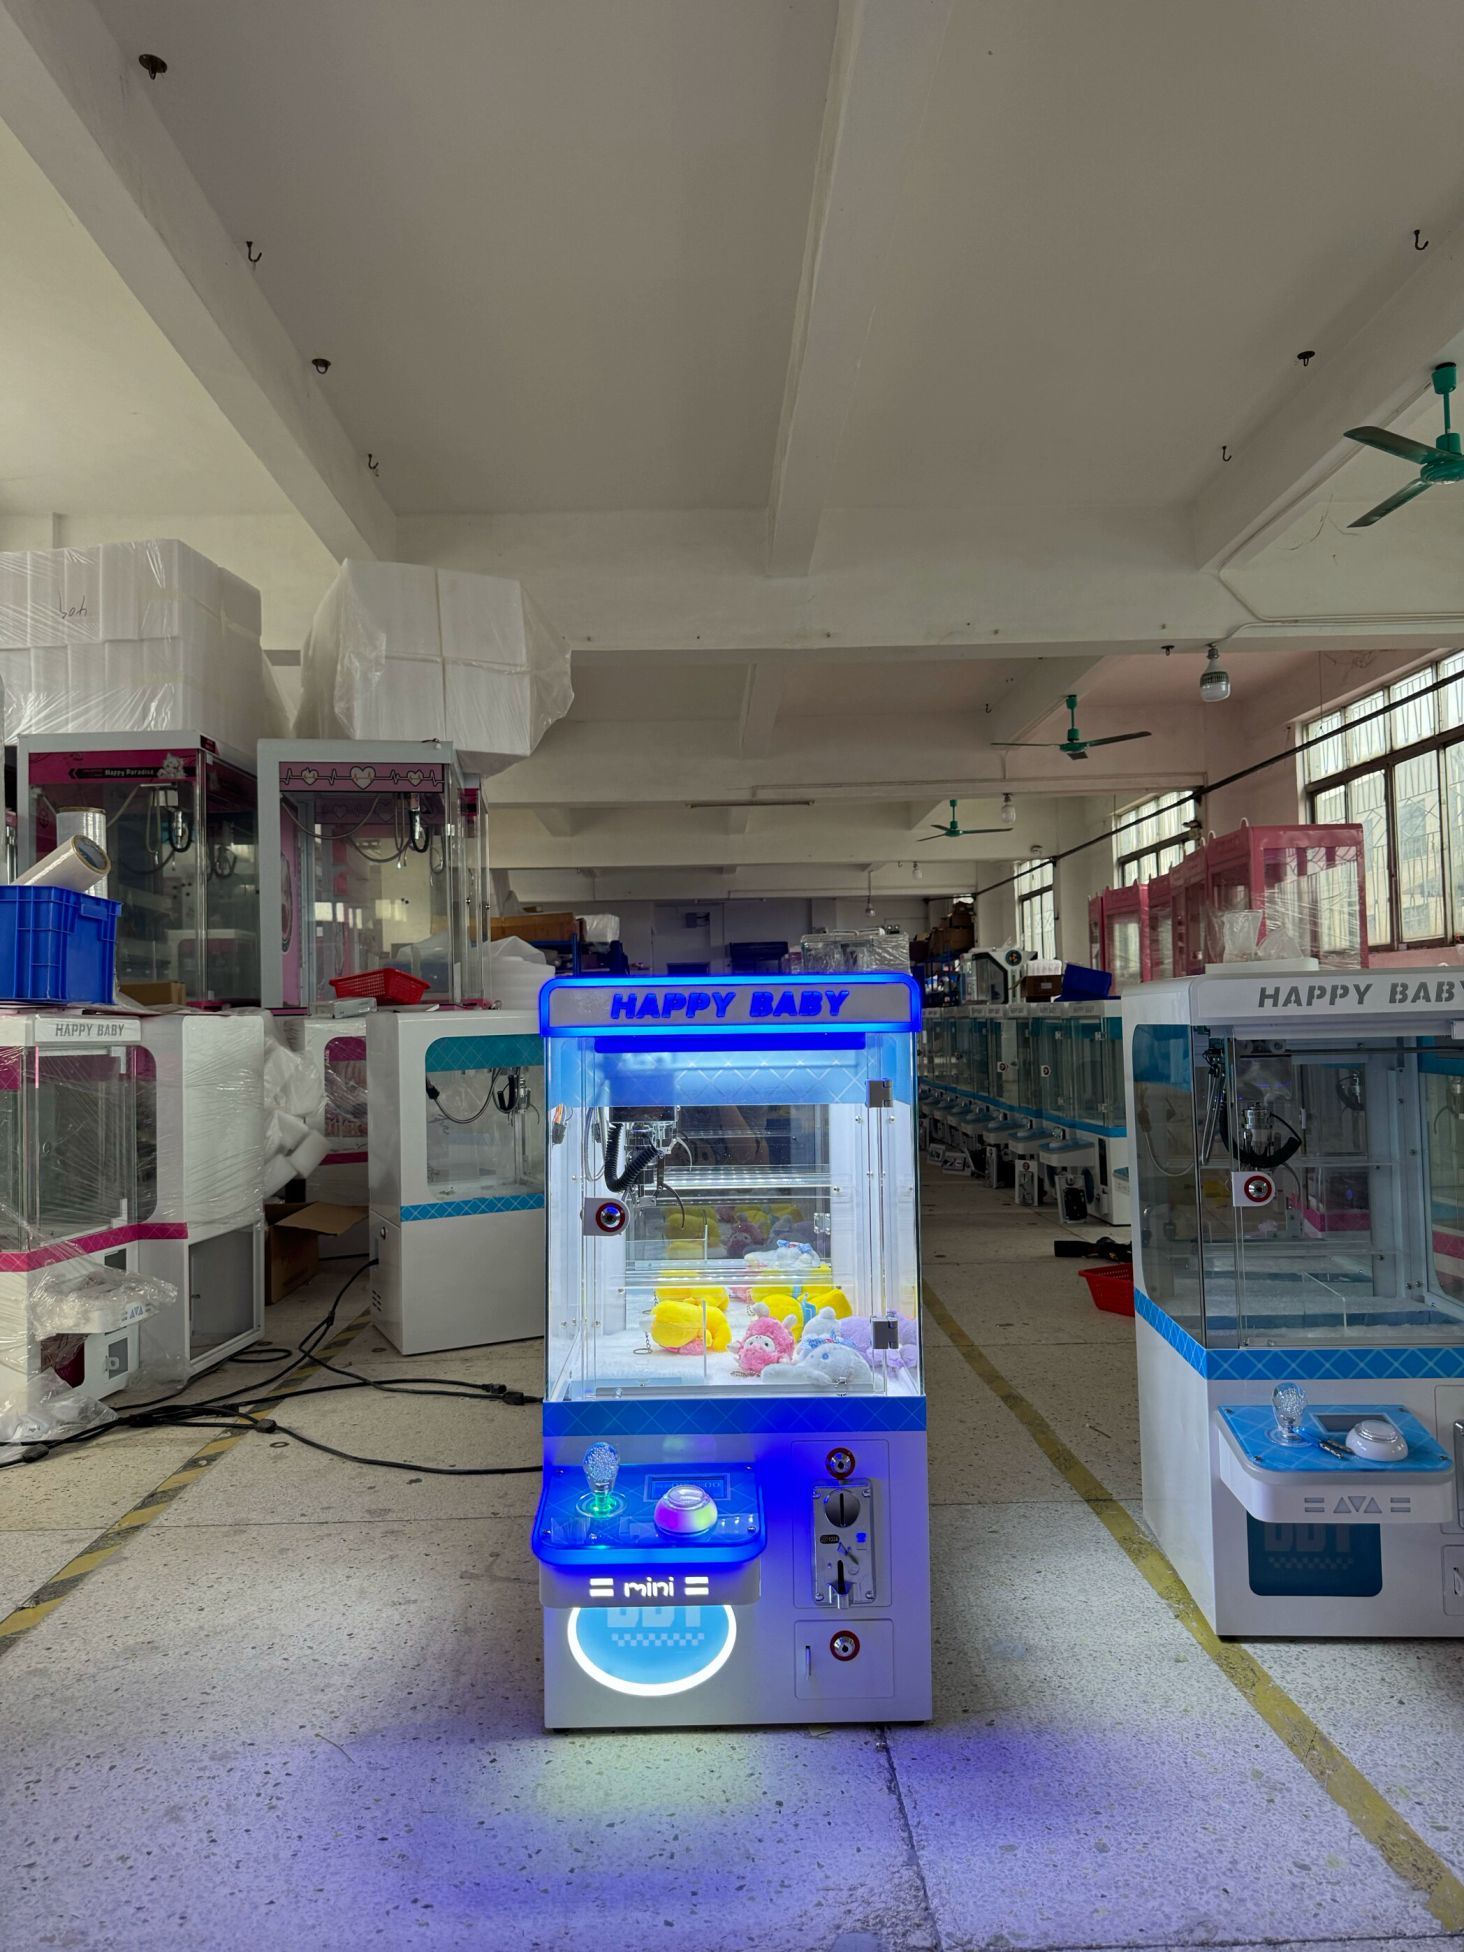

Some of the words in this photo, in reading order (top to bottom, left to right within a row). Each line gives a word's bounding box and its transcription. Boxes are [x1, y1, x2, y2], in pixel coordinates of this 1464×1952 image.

[611, 992, 736, 1019] HAPPY
[749, 990, 849, 1017] BABY
[1258, 983, 1374, 1008] HAPPY
[55, 1023, 94, 1037] HAPPY
[97, 1023, 125, 1036] BABY
[624, 1576, 674, 1598] mini
